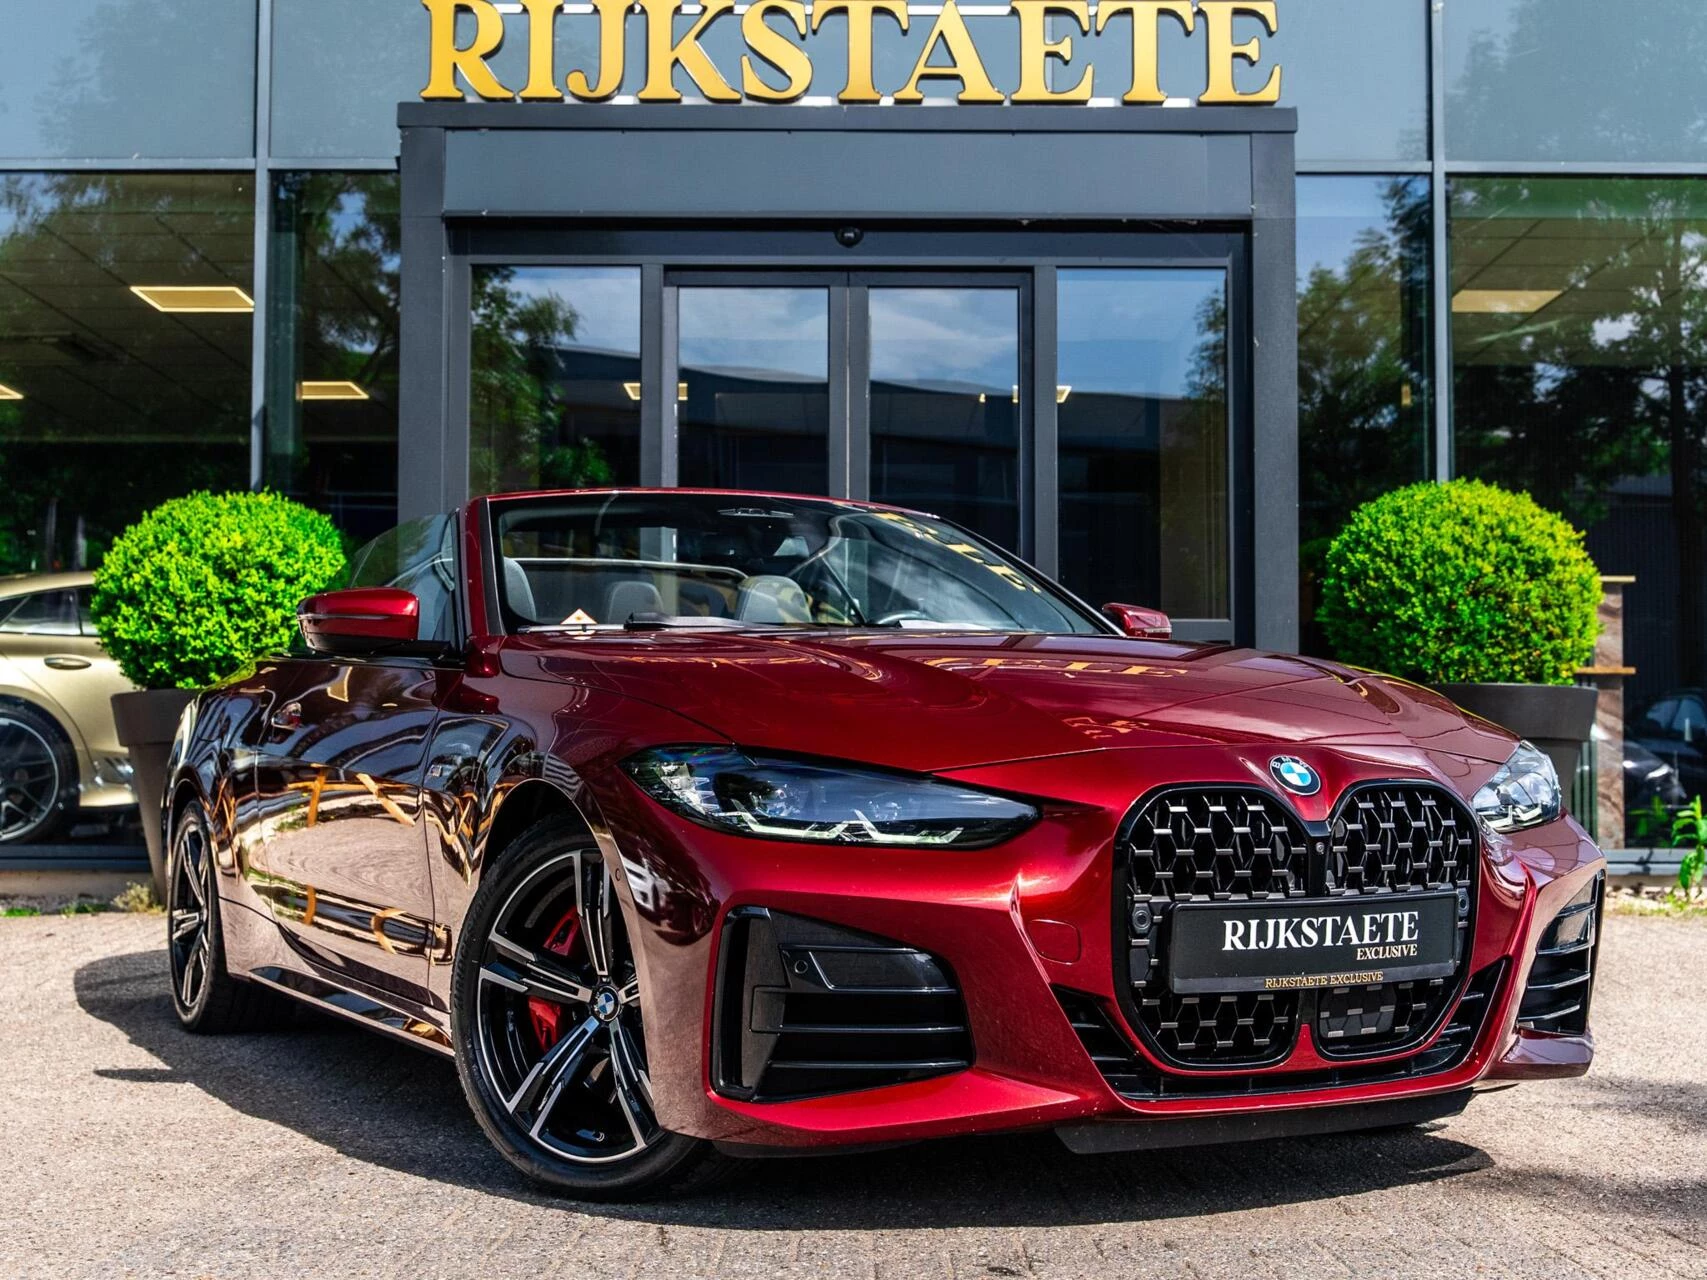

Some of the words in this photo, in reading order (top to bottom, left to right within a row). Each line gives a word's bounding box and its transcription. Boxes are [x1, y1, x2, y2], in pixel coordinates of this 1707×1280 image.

[420, 0, 1283, 105] RIJKSTAETE
[1222, 911, 1419, 951] RIJKSTAETE
[1356, 944, 1417, 960] EXCLUSIVE
[1264, 976, 1328, 989] RIJKSTAETE
[1331, 971, 1384, 985] EXCLUSIVE
